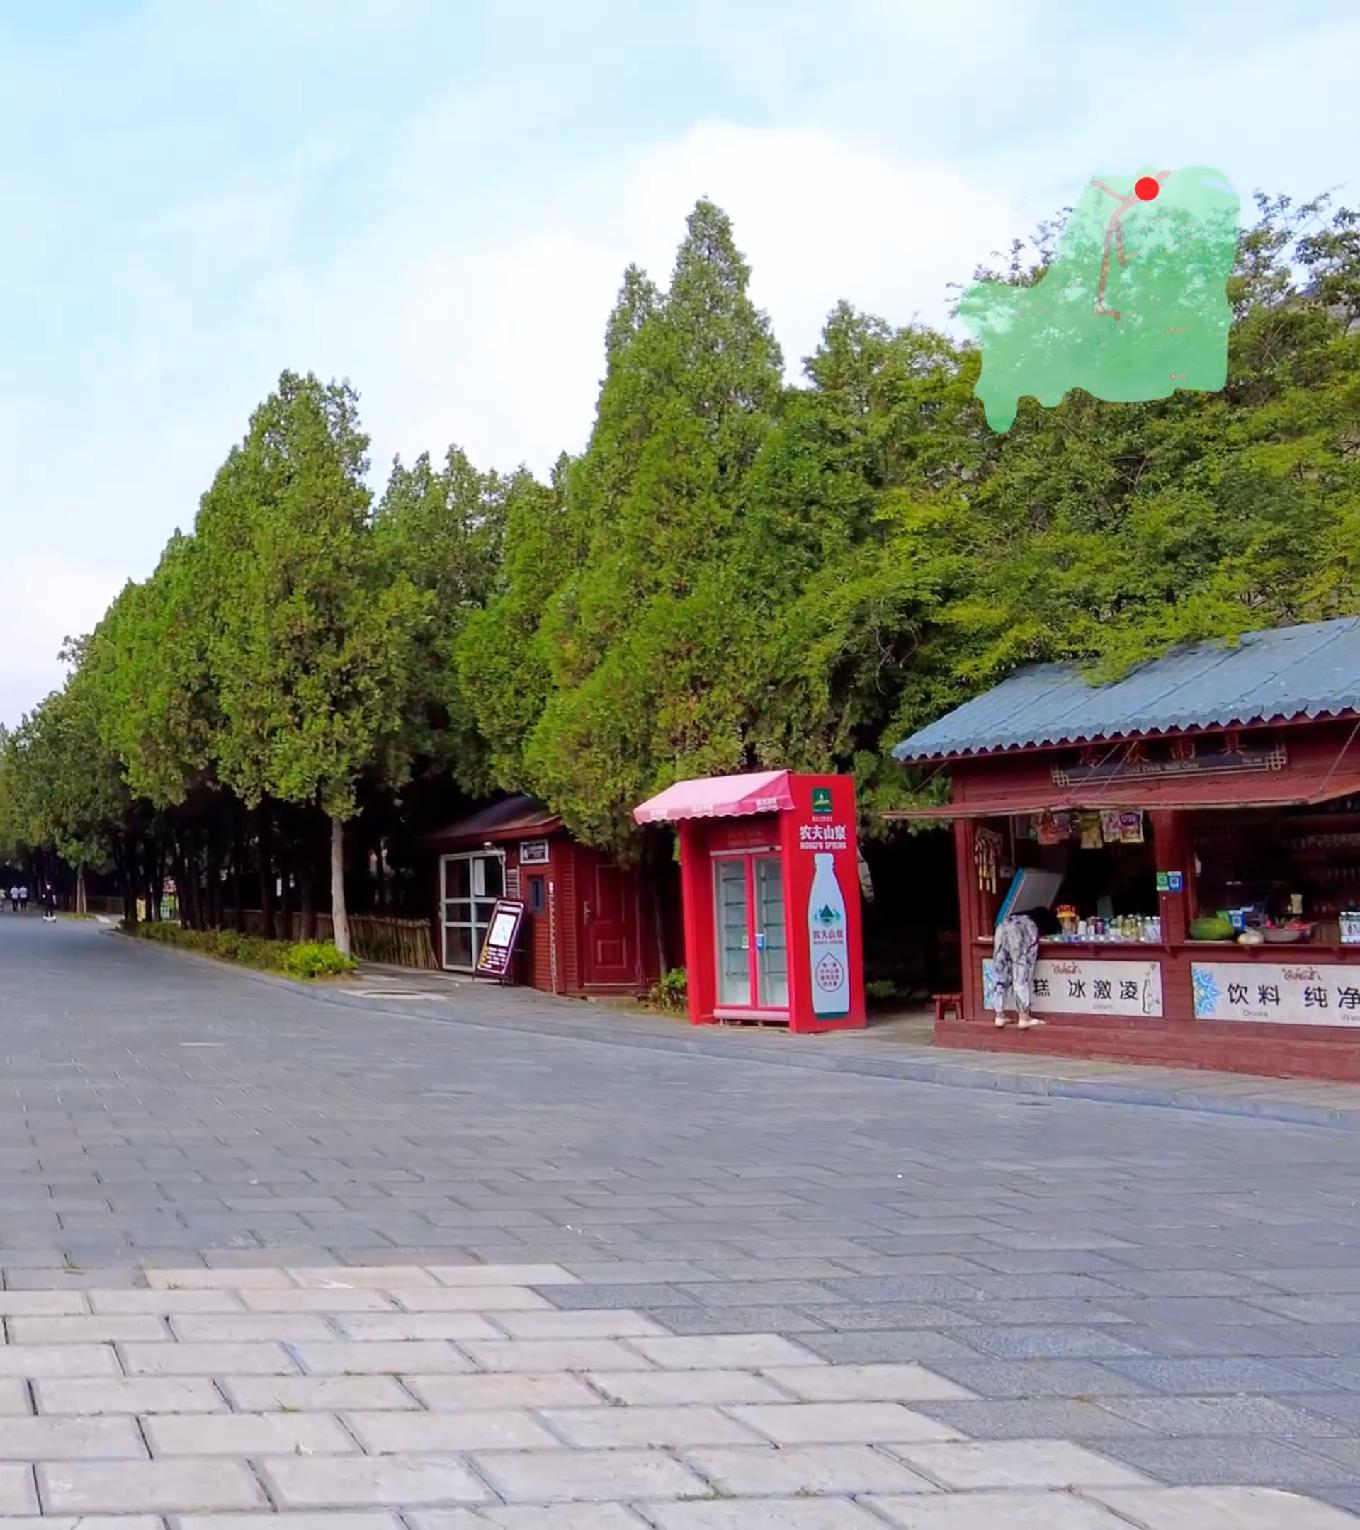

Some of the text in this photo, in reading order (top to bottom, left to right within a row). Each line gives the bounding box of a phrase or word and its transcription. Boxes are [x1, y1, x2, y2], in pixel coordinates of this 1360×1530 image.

[800, 824, 847, 841] 农夫山泉
[1032, 978, 1139, 1001] 糕 冰激凌
[1227, 983, 1360, 1010] 饮料 纯净
